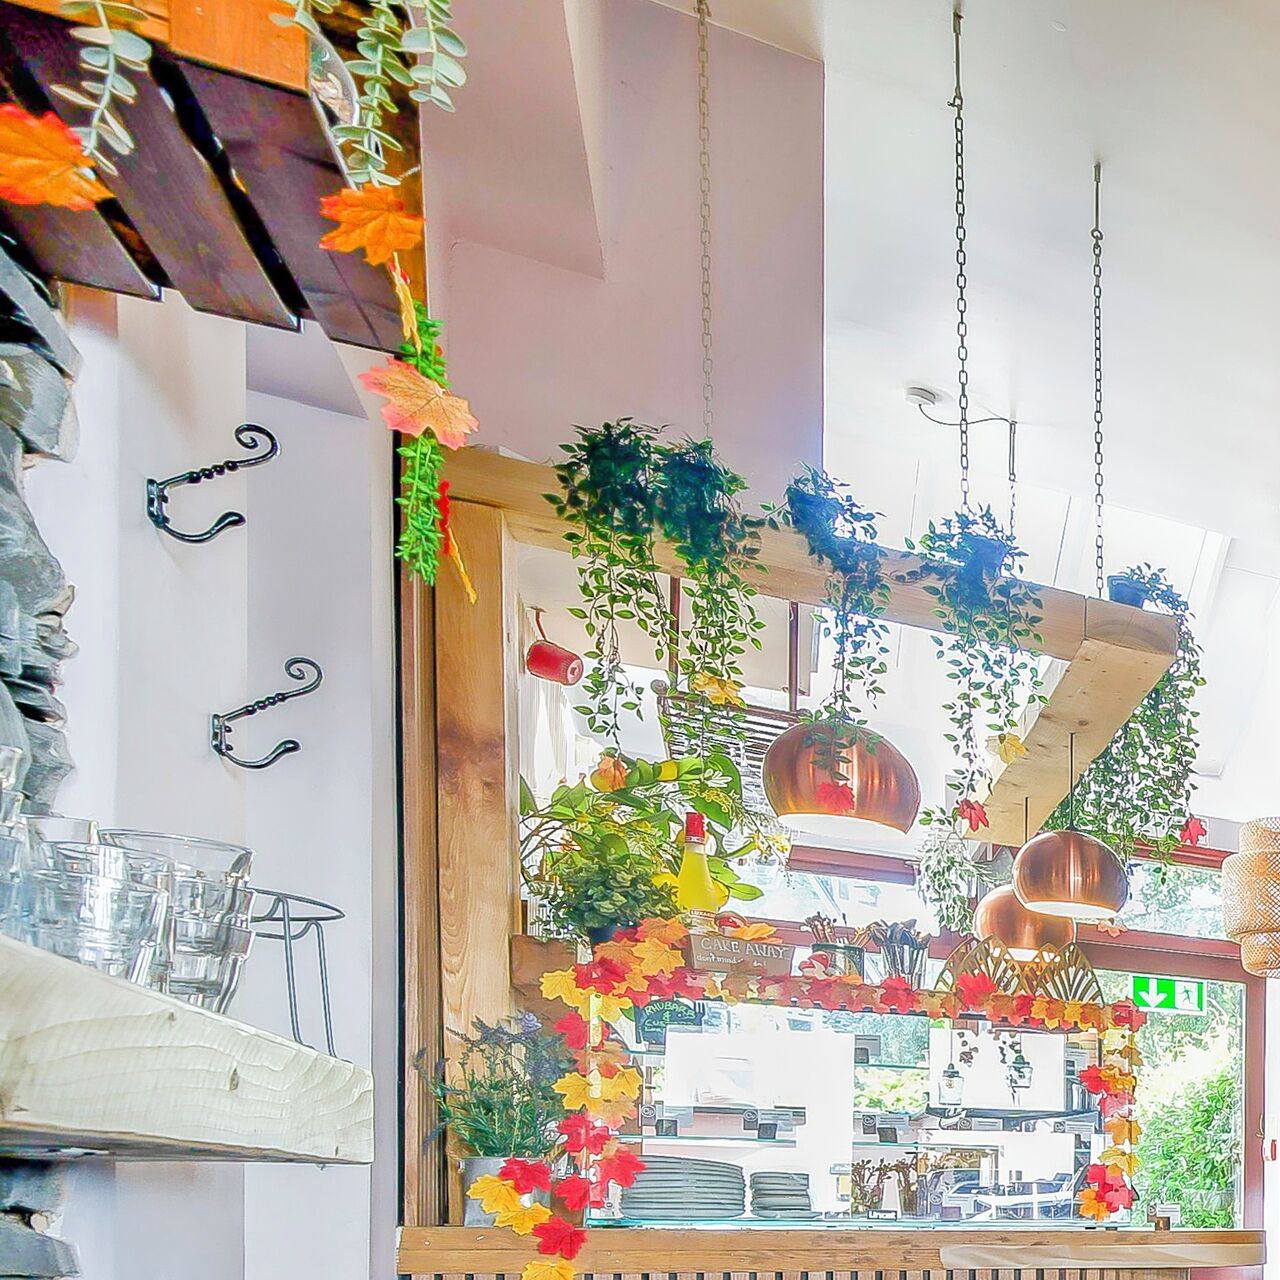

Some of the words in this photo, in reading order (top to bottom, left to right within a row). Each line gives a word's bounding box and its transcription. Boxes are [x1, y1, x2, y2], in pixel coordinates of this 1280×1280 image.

[700, 937, 740, 953] CAKE
[746, 943, 787, 959] AWAY
[645, 1001, 696, 1019] RHUBARB
